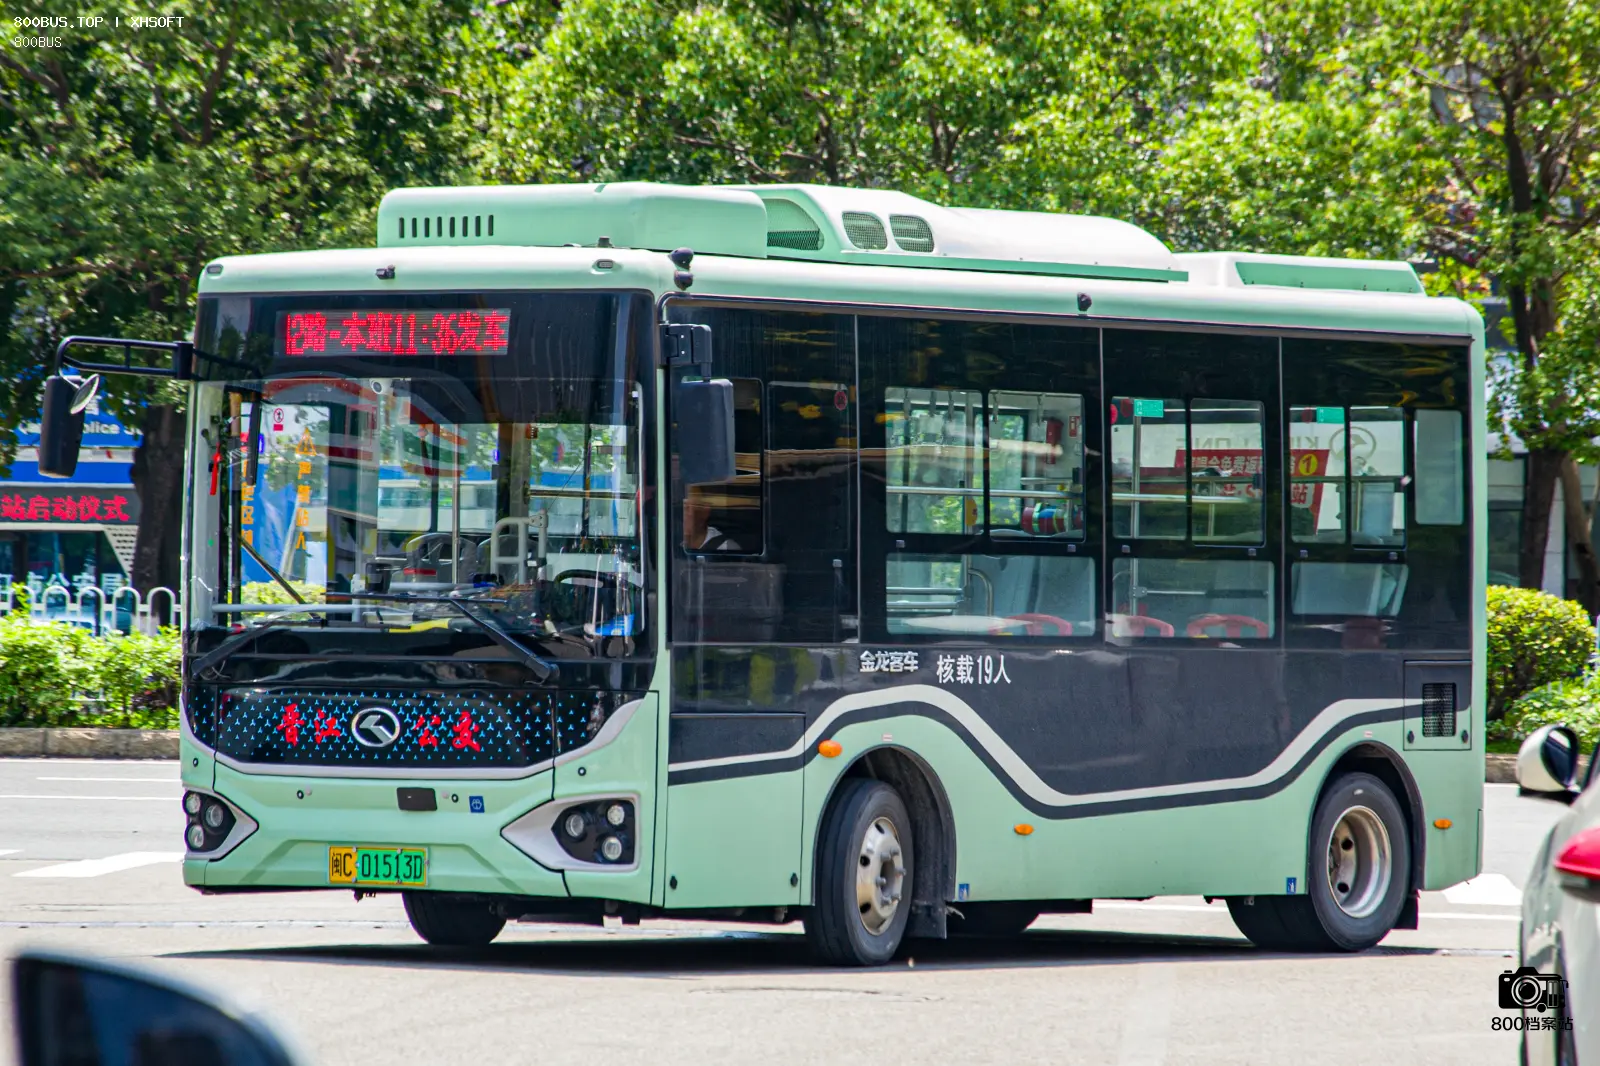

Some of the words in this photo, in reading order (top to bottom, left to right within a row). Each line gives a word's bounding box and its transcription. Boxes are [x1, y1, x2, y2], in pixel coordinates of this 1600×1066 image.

[83, 420, 121, 435] olice
[0, 494, 130, 522] 站启动仪式
[859, 650, 919, 673] 金龙客车
[936, 655, 1012, 685] 核载19人
[276, 703, 341, 747] 晋江
[413, 710, 481, 753] 公交
[331, 852, 353, 877] 闽C
[361, 853, 423, 880] 01513D
